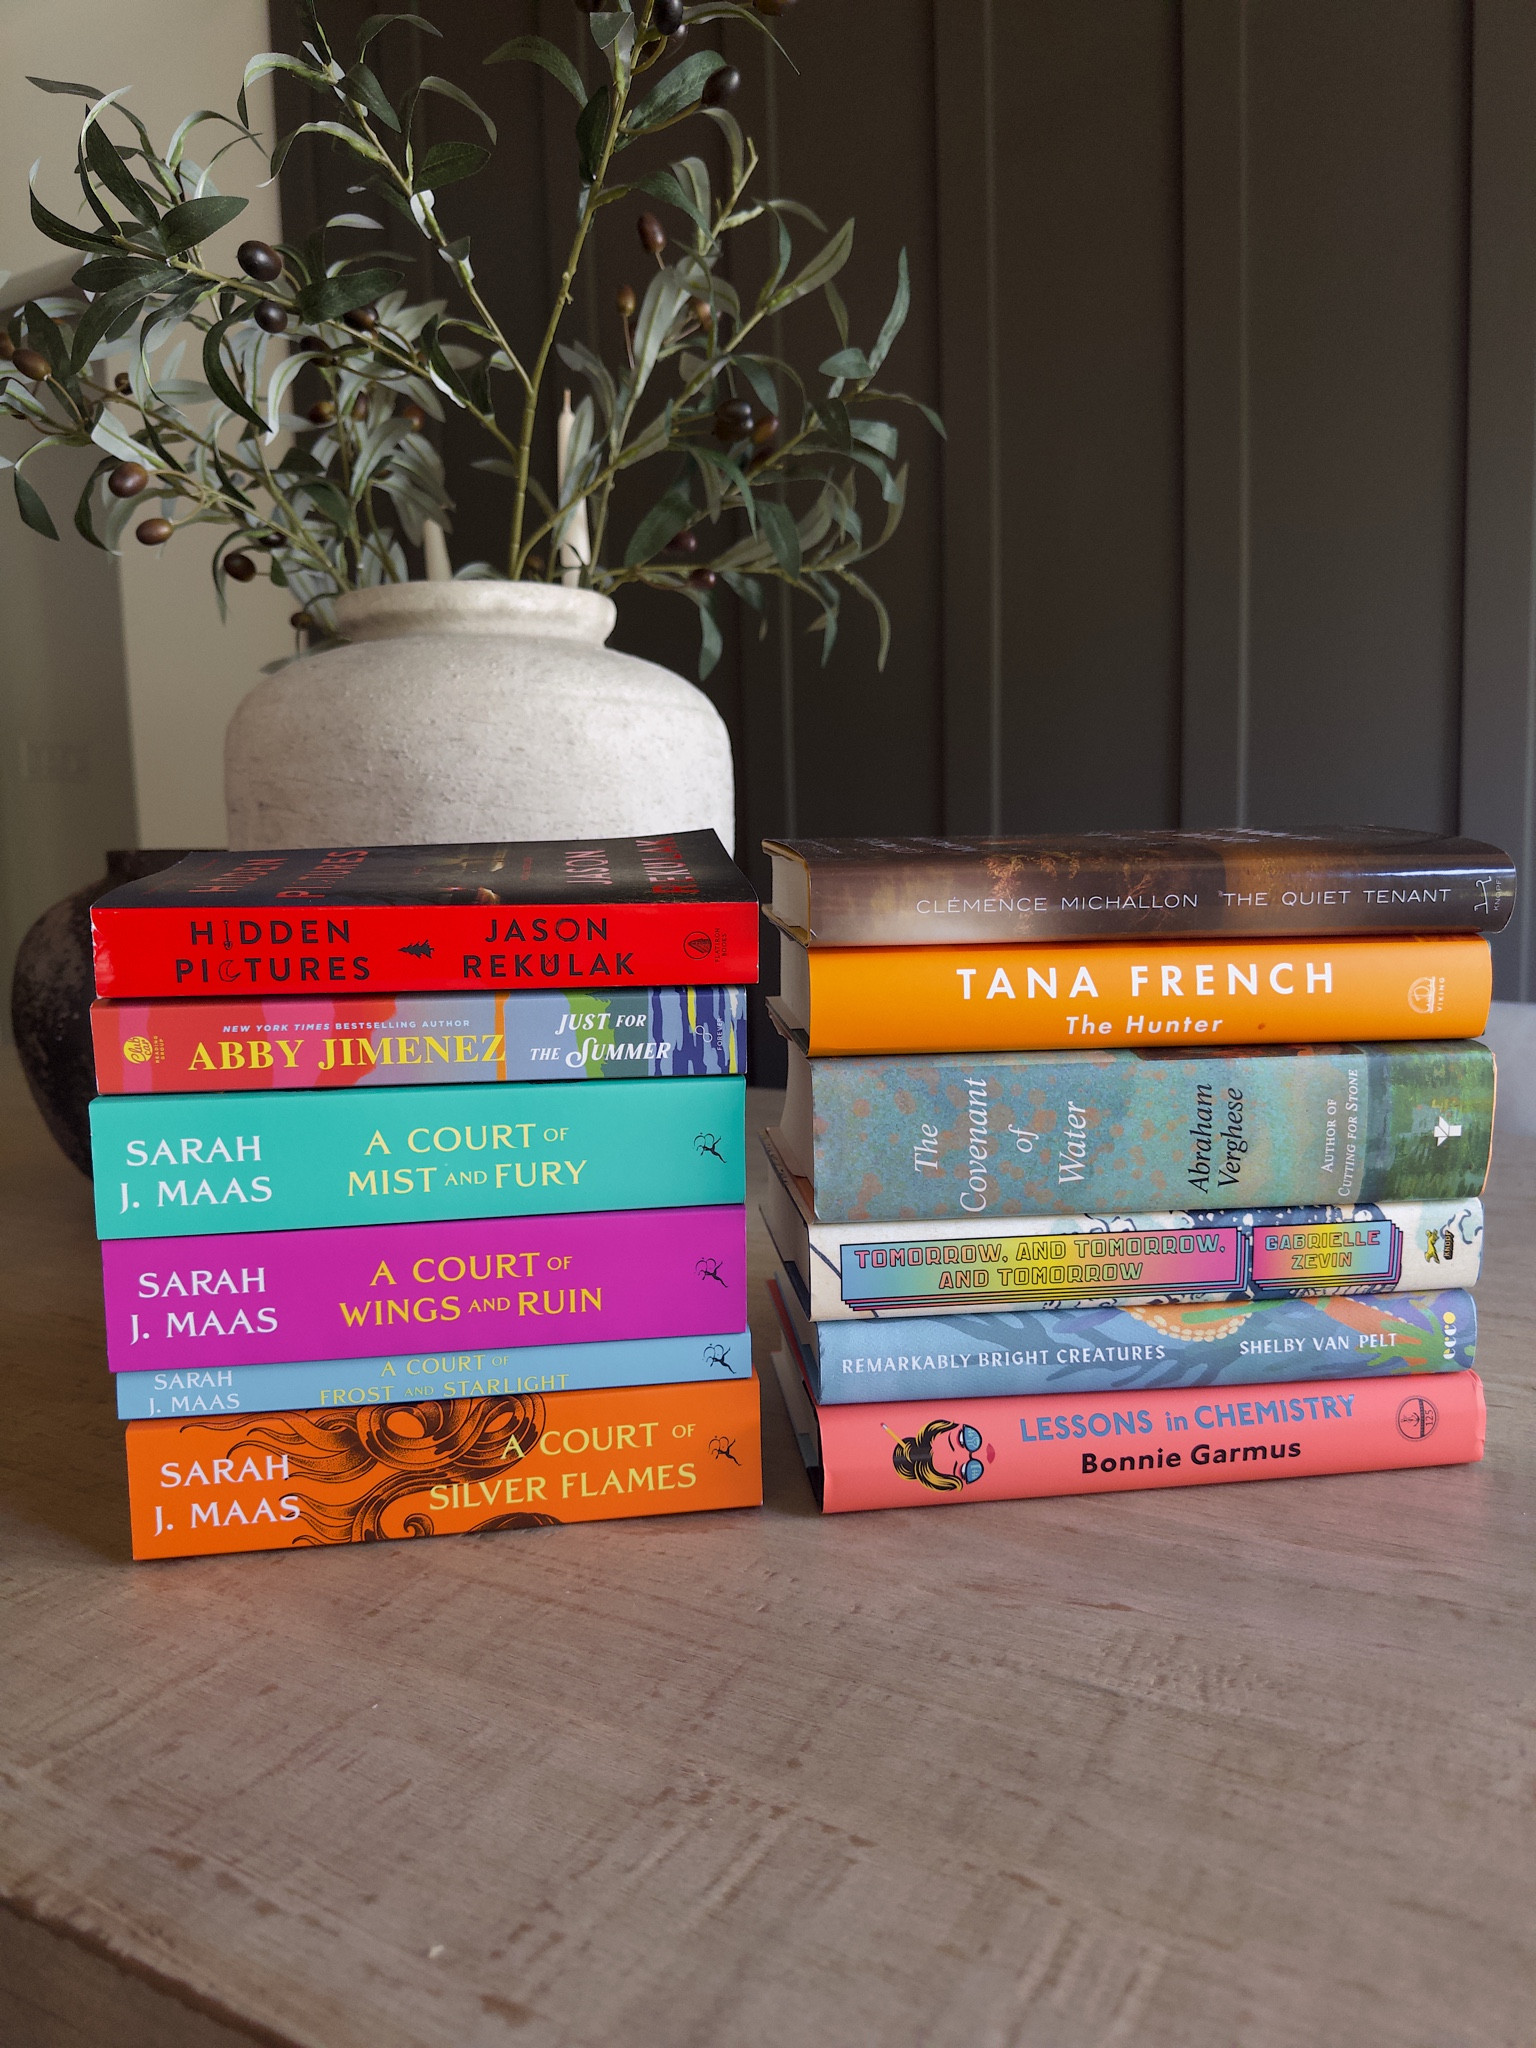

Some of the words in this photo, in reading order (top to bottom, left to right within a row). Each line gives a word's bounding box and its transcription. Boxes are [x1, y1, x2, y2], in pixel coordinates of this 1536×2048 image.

[565, 850, 613, 885] JASON
[636, 837, 700, 893] REKULAK
[916, 896, 1047, 914] CLÉMENCE
[1061, 894, 1198, 911] MICHALLON
[1222, 892, 1269, 907] THE
[1281, 890, 1352, 906] QUIET
[1362, 888, 1452, 904] TENANT
[1493, 879, 1502, 911] KNOPF
[190, 920, 350, 950] HIDDEN
[485, 918, 607, 942] JASON
[176, 956, 370, 983] PICTURES
[463, 952, 635, 978] REKULAK
[956, 966, 1099, 1000] TANA
[1130, 962, 1333, 997] FRENCH
[1437, 977, 1445, 1012] VIKING
[222, 1025, 251, 1033] NEW
[256, 1024, 288, 1032] YORK
[294, 1023, 330, 1031] TIMES
[335, 1021, 416, 1030] BESTSELLING
[422, 1020, 470, 1028] AUTHOR
[555, 1013, 611, 1035] JUST
[615, 1014, 647, 1028] FOR
[1065, 1014, 1113, 1035] The
[1125, 1015, 1224, 1034] Hunter
[188, 1039, 304, 1071] ABBY
[318, 1034, 506, 1070] JIMENEZ
[530, 1047, 561, 1061] THE
[565, 1037, 671, 1068] SUMMER
[1327, 1099, 1337, 1115] OF
[1345, 1069, 1358, 1112] STONE
[364, 1129, 392, 1156] A
[407, 1123, 536, 1153] COURT
[543, 1127, 569, 1142] OF
[959, 1076, 988, 1212] Covenant
[1008, 1124, 1039, 1153] of
[1058, 1100, 1087, 1184] Water
[1188, 1083, 1213, 1194] Abraham
[1217, 1087, 1248, 1188] Verghese
[1347, 1116, 1358, 1140] FOR
[126, 1136, 262, 1166] SARAH
[913, 1122, 939, 1172] The
[1321, 1119, 1337, 1173] AUTHOR
[347, 1167, 438, 1197] MIST
[444, 1171, 488, 1187] AND
[495, 1160, 588, 1189] FURY
[1338, 1143, 1356, 1197] CUTTING
[120, 1183, 140, 1214] J.
[157, 1176, 273, 1207] MAAS
[854, 1244, 1009, 1269] TOMORROW,
[1016, 1240, 1066, 1261] AND
[1074, 1233, 1226, 1257] TOMORROW,
[1264, 1230, 1380, 1251] GABRIELLE
[1444, 1230, 1452, 1257] KNOPF
[369, 1260, 397, 1286] A
[412, 1252, 540, 1283] COURT
[547, 1256, 573, 1271] OF
[938, 1269, 989, 1290] AND
[997, 1262, 1143, 1286] TOMORROW
[1291, 1251, 1353, 1270] ZEVIN
[138, 1267, 266, 1299] SARAH
[338, 1296, 461, 1328] WINGS
[468, 1297, 511, 1313] AND
[518, 1287, 602, 1317] RUIN
[130, 1314, 150, 1346] J.
[166, 1307, 279, 1338] MAAS
[380, 1361, 397, 1377] A
[406, 1354, 486, 1375] COURT
[491, 1355, 509, 1367] OF
[842, 1354, 971, 1374] REMARKABLY
[978, 1349, 1049, 1367] BRIGHT
[1056, 1345, 1165, 1364] CREATURES
[1239, 1337, 1305, 1355] SHELBY
[1312, 1335, 1349, 1350] VAN
[1359, 1332, 1396, 1349] PELT
[154, 1370, 233, 1391] SARAH
[320, 1386, 395, 1405] FROST
[404, 1385, 434, 1398] AND
[442, 1374, 570, 1398] STARLIGHT
[149, 1398, 162, 1417] J.
[171, 1393, 240, 1413] MAAS
[1020, 1410, 1153, 1442] LESSONS
[1166, 1412, 1188, 1432] in
[1194, 1394, 1355, 1429] CHEMISTRY
[1425, 1409, 1434, 1426] 125
[500, 1434, 526, 1460] A
[539, 1422, 659, 1456] COURT
[672, 1423, 697, 1439] OF
[160, 1454, 290, 1488] SARAH
[1082, 1447, 1181, 1474] Bonnie
[1190, 1442, 1301, 1466] Garmus
[429, 1476, 548, 1511] SILVER
[561, 1462, 697, 1499] FLAMES
[153, 1506, 174, 1537] J.
[190, 1495, 301, 1529] MAAS
